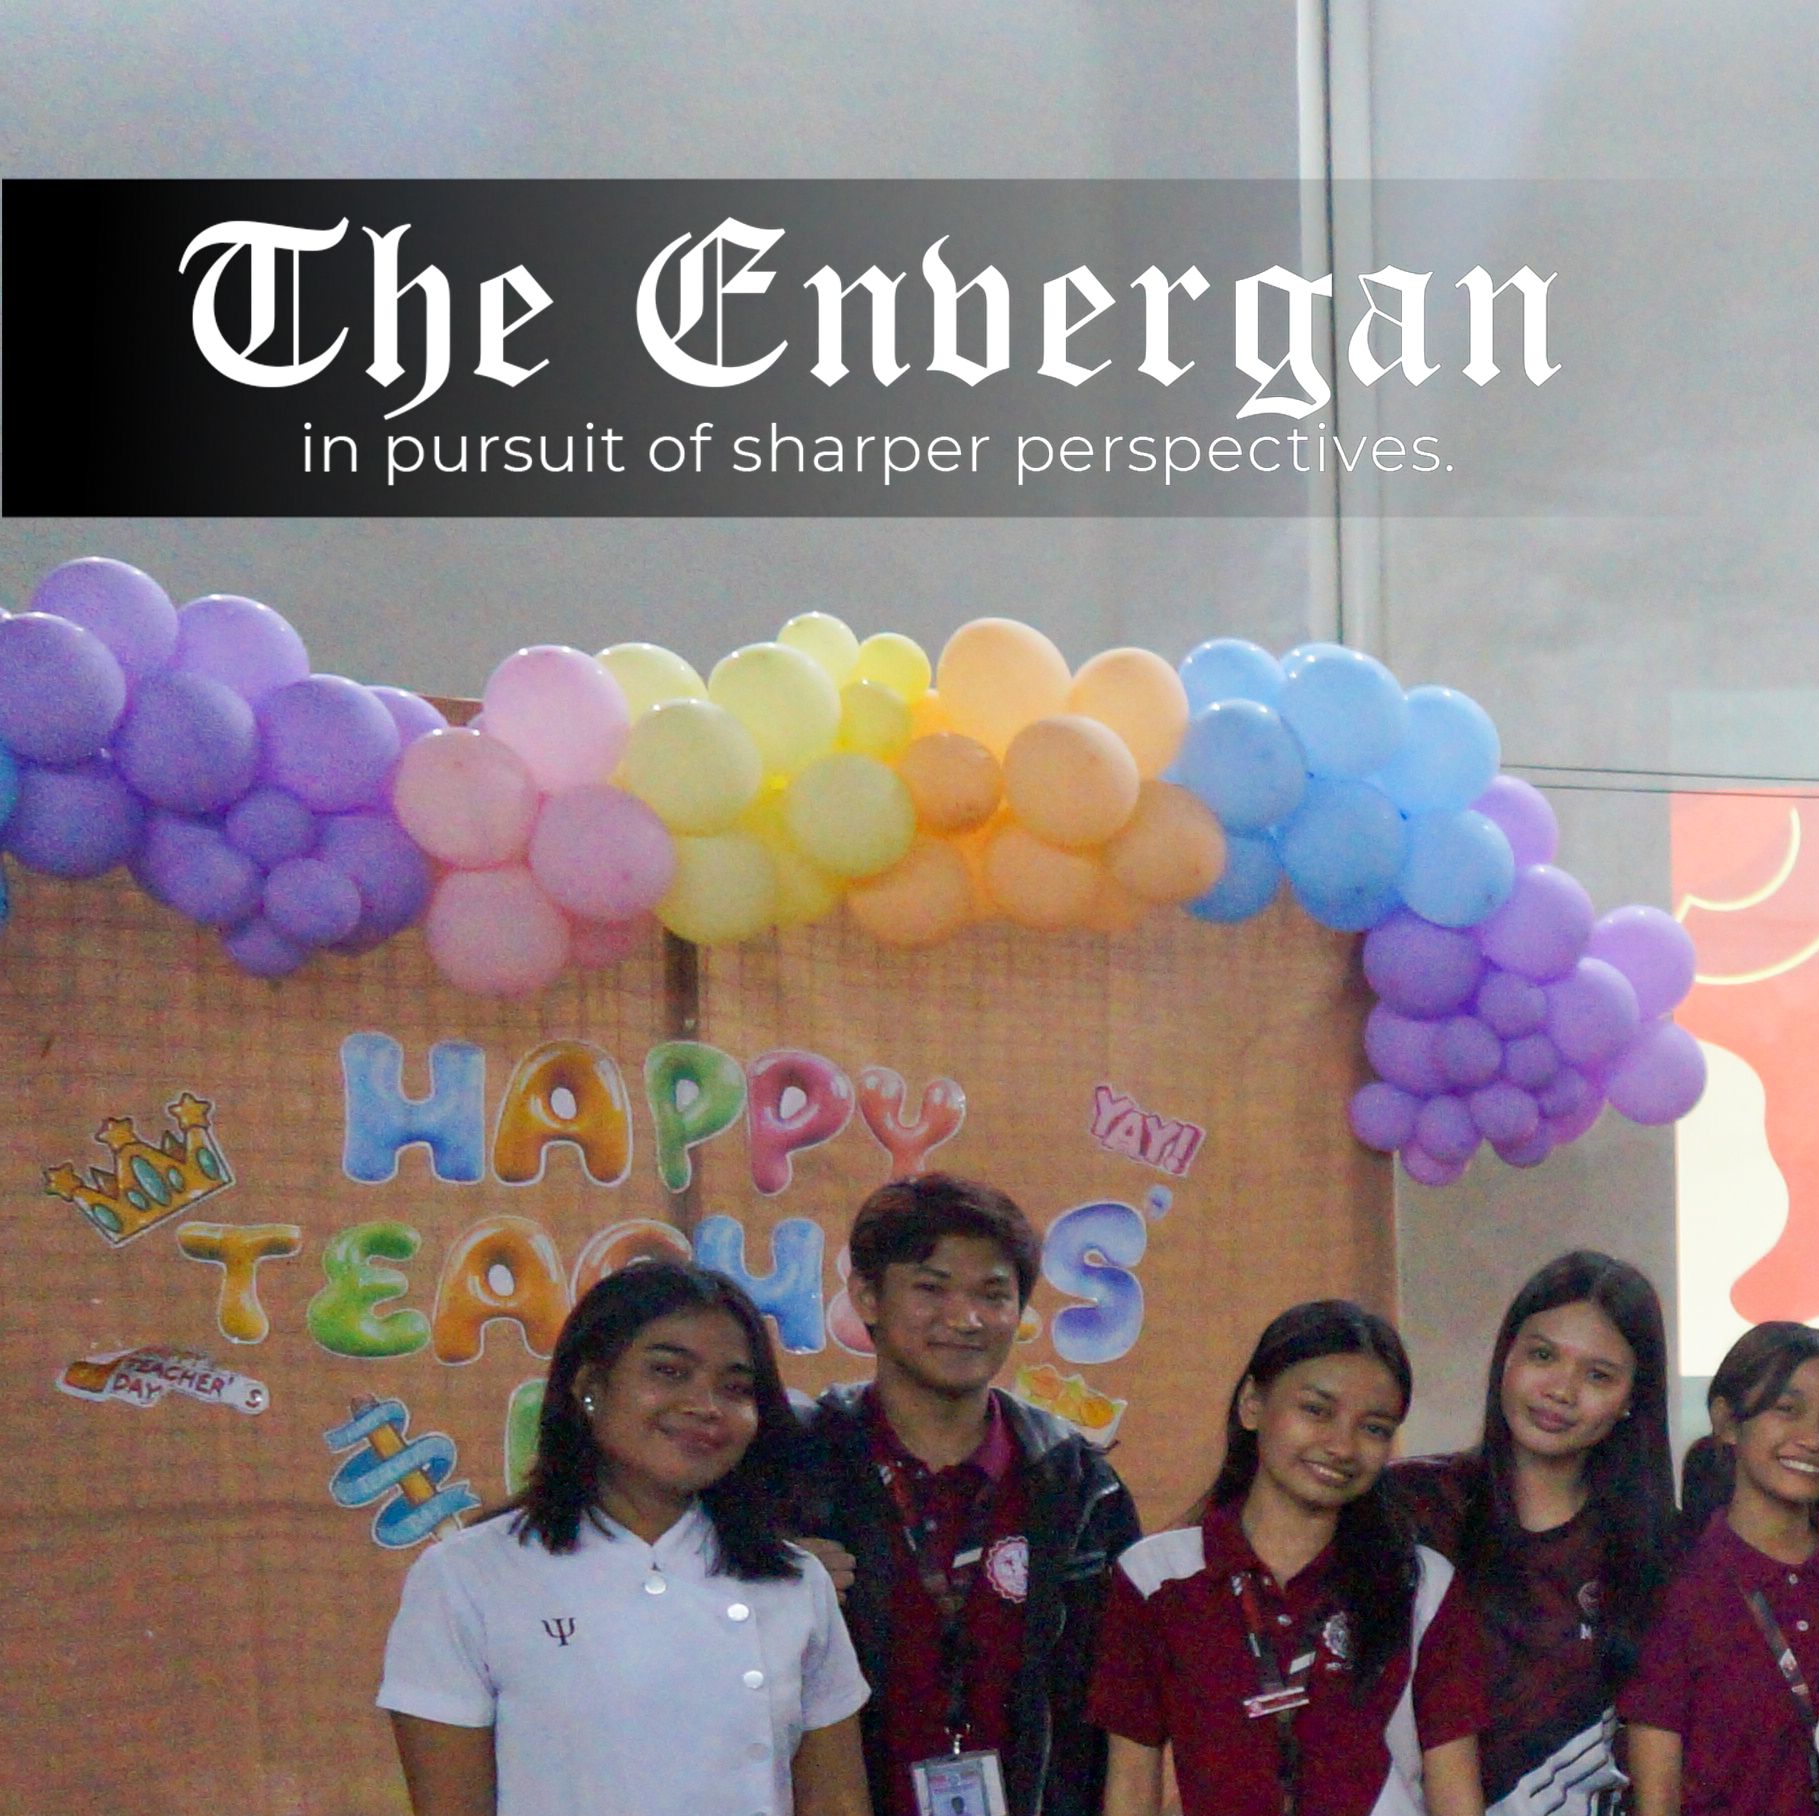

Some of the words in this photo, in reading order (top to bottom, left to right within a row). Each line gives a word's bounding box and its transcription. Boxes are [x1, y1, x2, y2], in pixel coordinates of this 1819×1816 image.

[340, 1030, 967, 1196] HAPPY
[1088, 1084, 1207, 1177] YAY!
[112, 1373, 163, 1400] DAY
